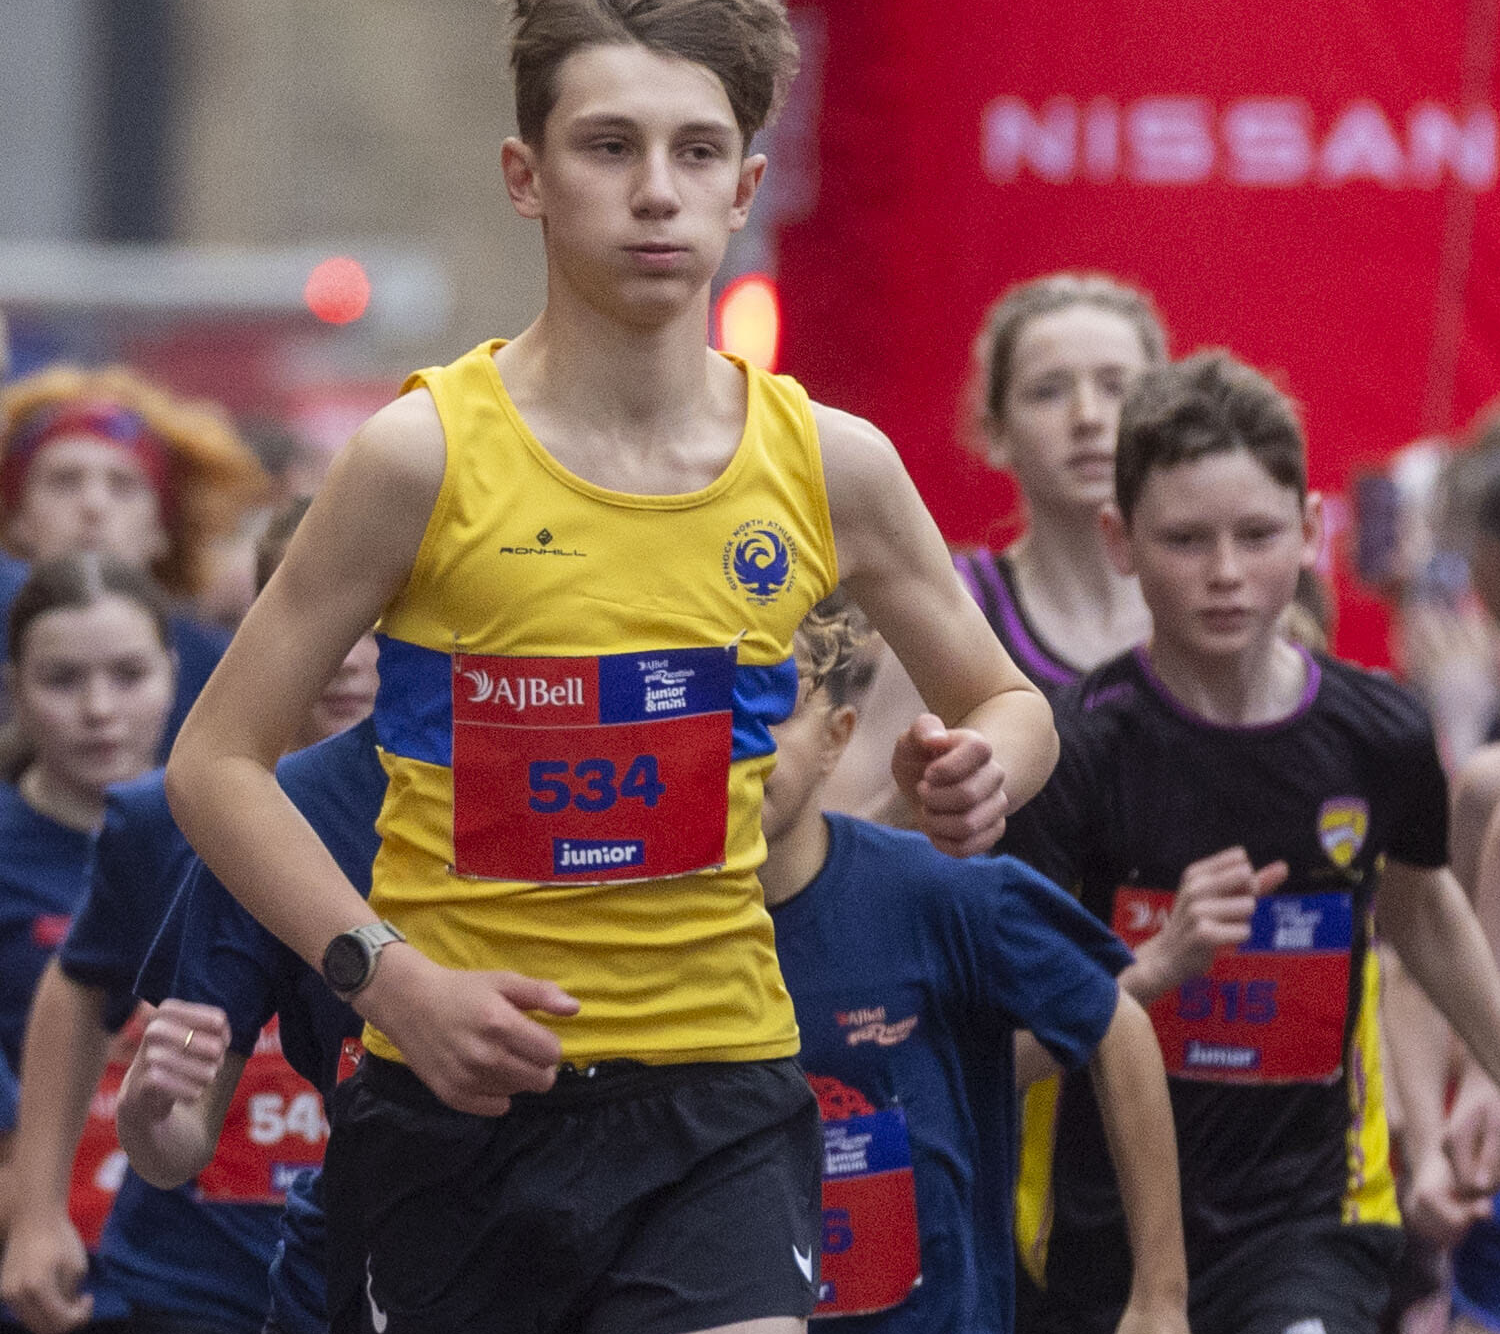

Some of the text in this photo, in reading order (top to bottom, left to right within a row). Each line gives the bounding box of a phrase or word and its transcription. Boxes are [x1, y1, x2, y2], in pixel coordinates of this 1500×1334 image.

[732, 519, 763, 537] NORTH
[499, 547, 588, 557] RONHILL
[494, 677, 585, 711] AJBell
[645, 686, 687, 701] junior
[528, 754, 666, 814] 534
[560, 843, 637, 867] junior
[249, 1092, 331, 1145] 54
